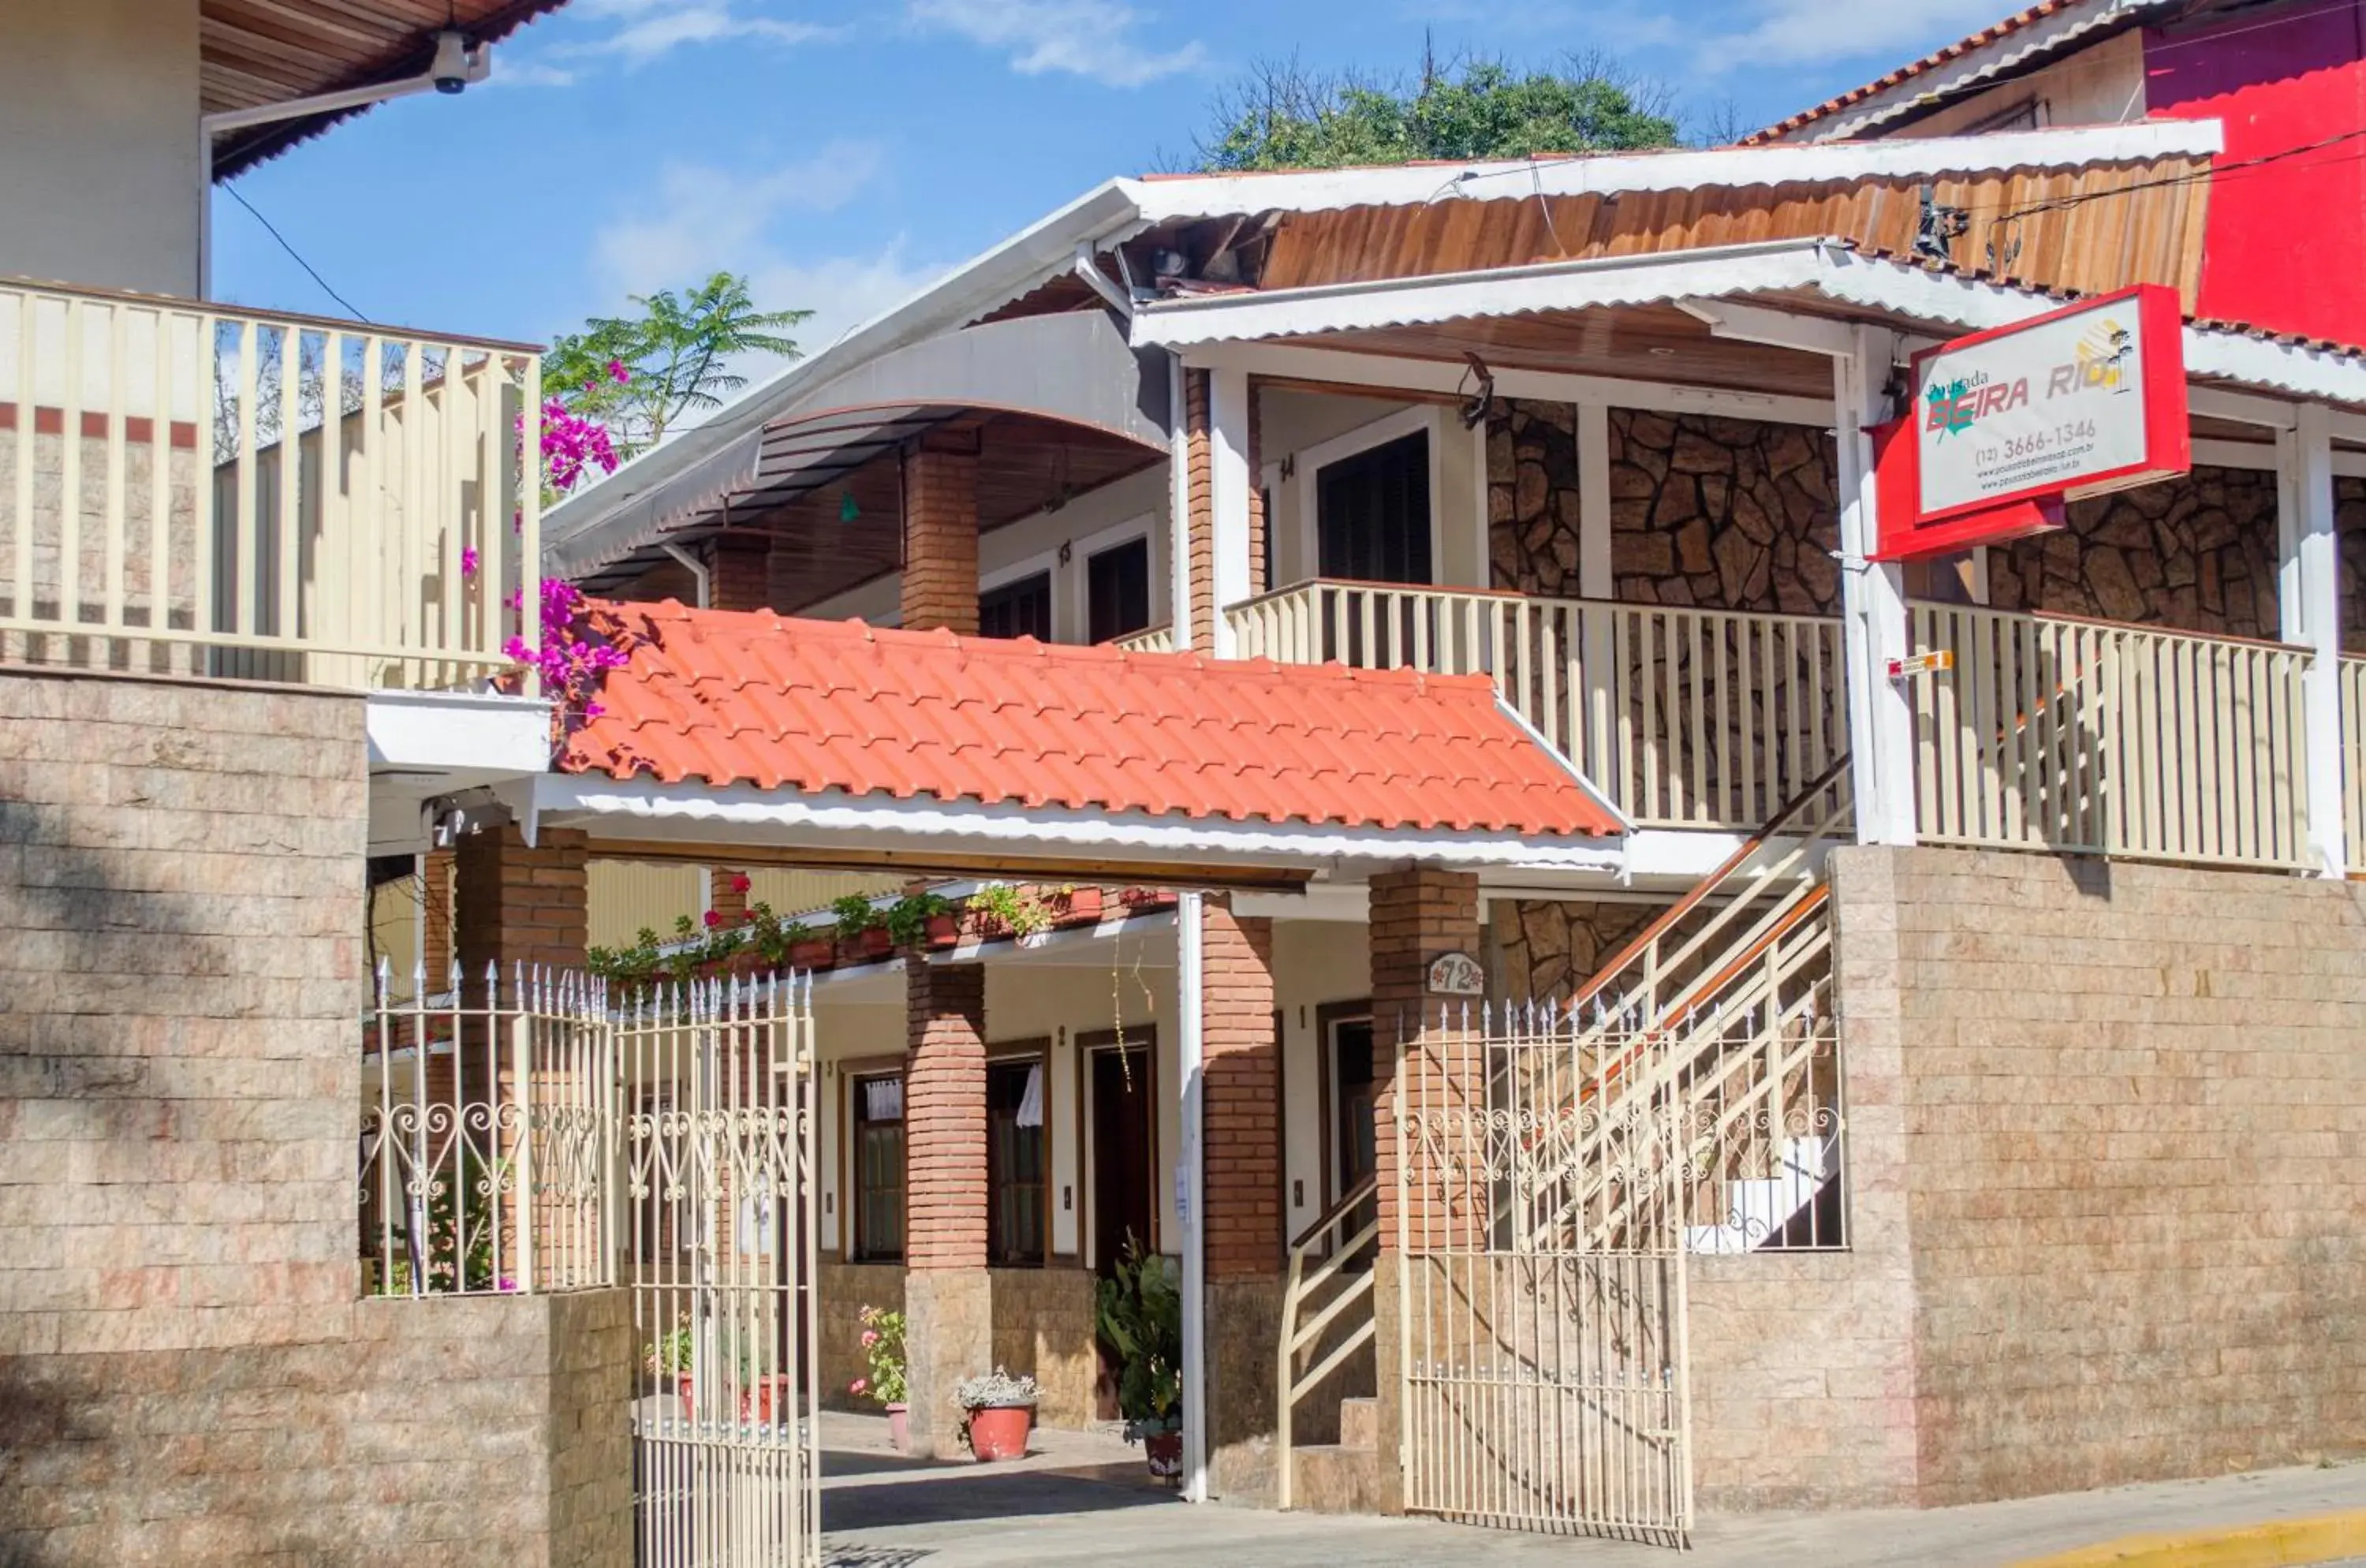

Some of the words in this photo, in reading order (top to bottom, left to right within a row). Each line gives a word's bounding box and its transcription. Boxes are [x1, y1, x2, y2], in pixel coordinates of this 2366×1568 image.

[1926, 377, 2028, 433] BEIRA
[2046, 355, 2111, 399] RIO
[1976, 446, 1998, 467] (12)
[2003, 418, 2096, 460] 3666-1346
[1441, 960, 1472, 990] 72
